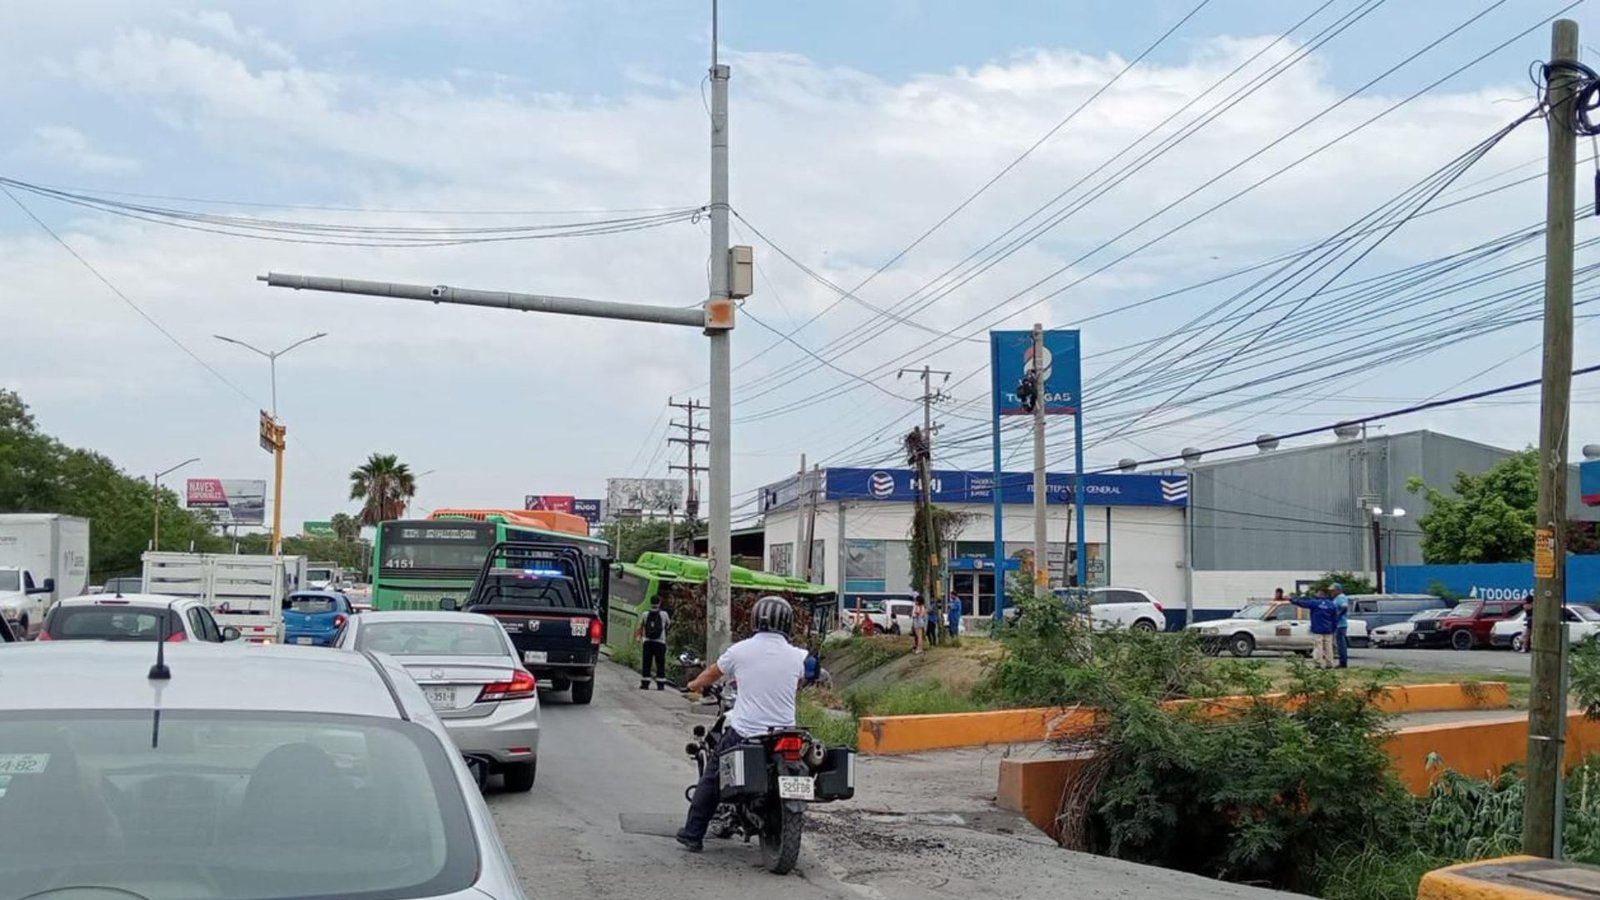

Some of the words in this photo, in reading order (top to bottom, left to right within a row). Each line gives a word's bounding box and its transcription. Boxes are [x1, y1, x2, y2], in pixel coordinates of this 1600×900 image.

[1006, 392, 1072, 402] TOGAS
[189, 481, 216, 492] NAVES
[1086, 484, 1122, 495] GENERAL
[386, 559, 415, 569] 4151
